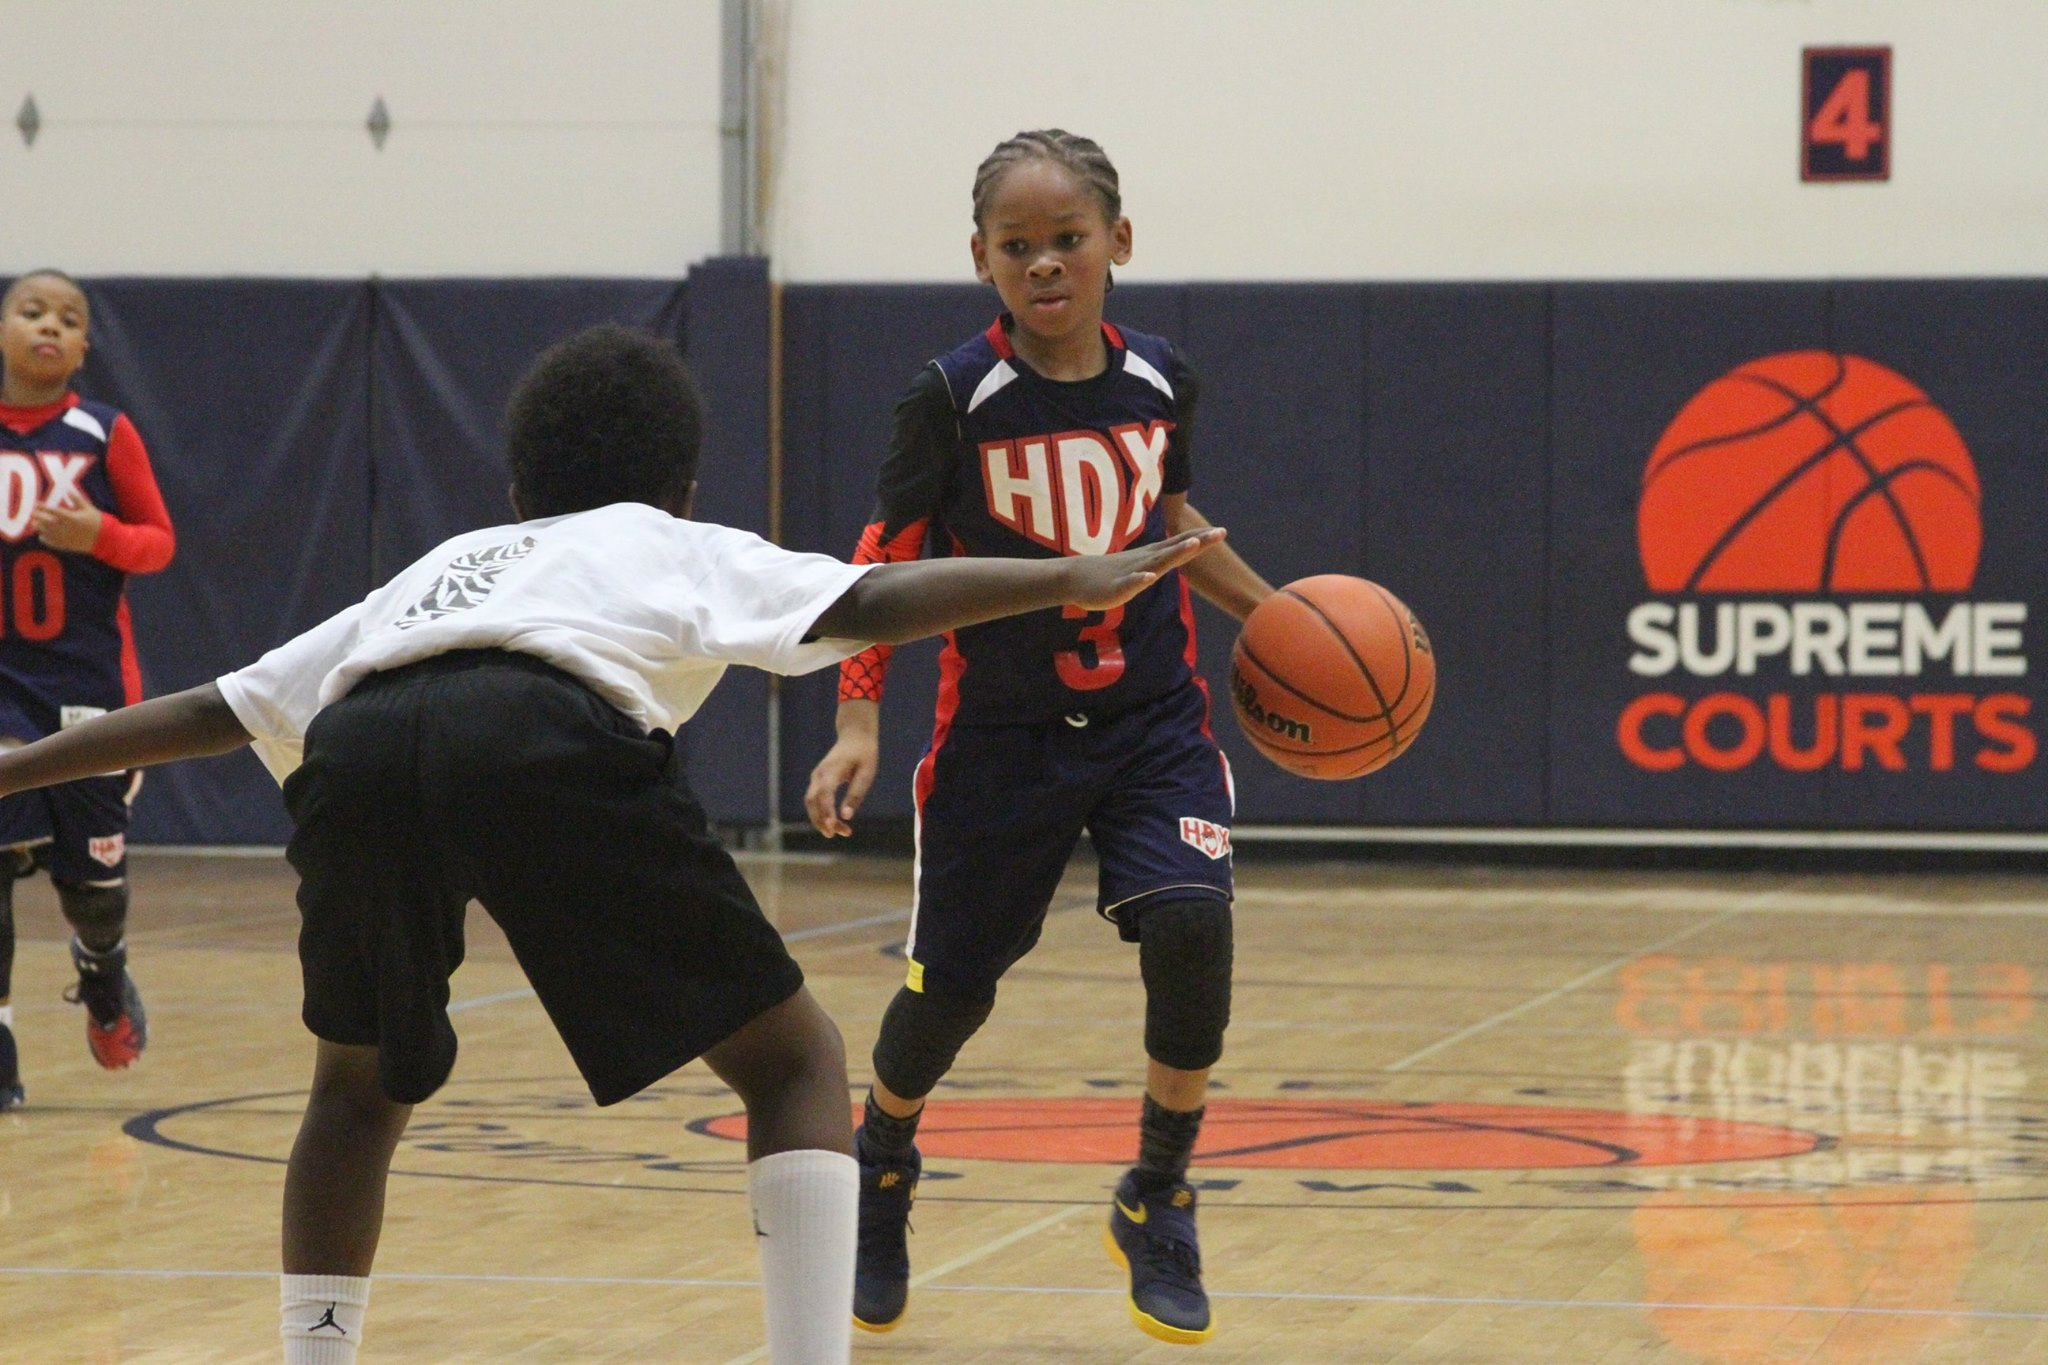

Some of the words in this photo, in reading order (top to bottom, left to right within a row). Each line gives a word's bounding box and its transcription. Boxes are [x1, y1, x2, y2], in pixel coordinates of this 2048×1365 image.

[1811, 67, 1880, 160] 4
[979, 419, 1175, 557] HDX
[0, 552, 66, 641] 0
[1627, 602, 2027, 677] SUPREME
[1054, 602, 1126, 691] 3
[1617, 692, 2038, 773] COURTS
